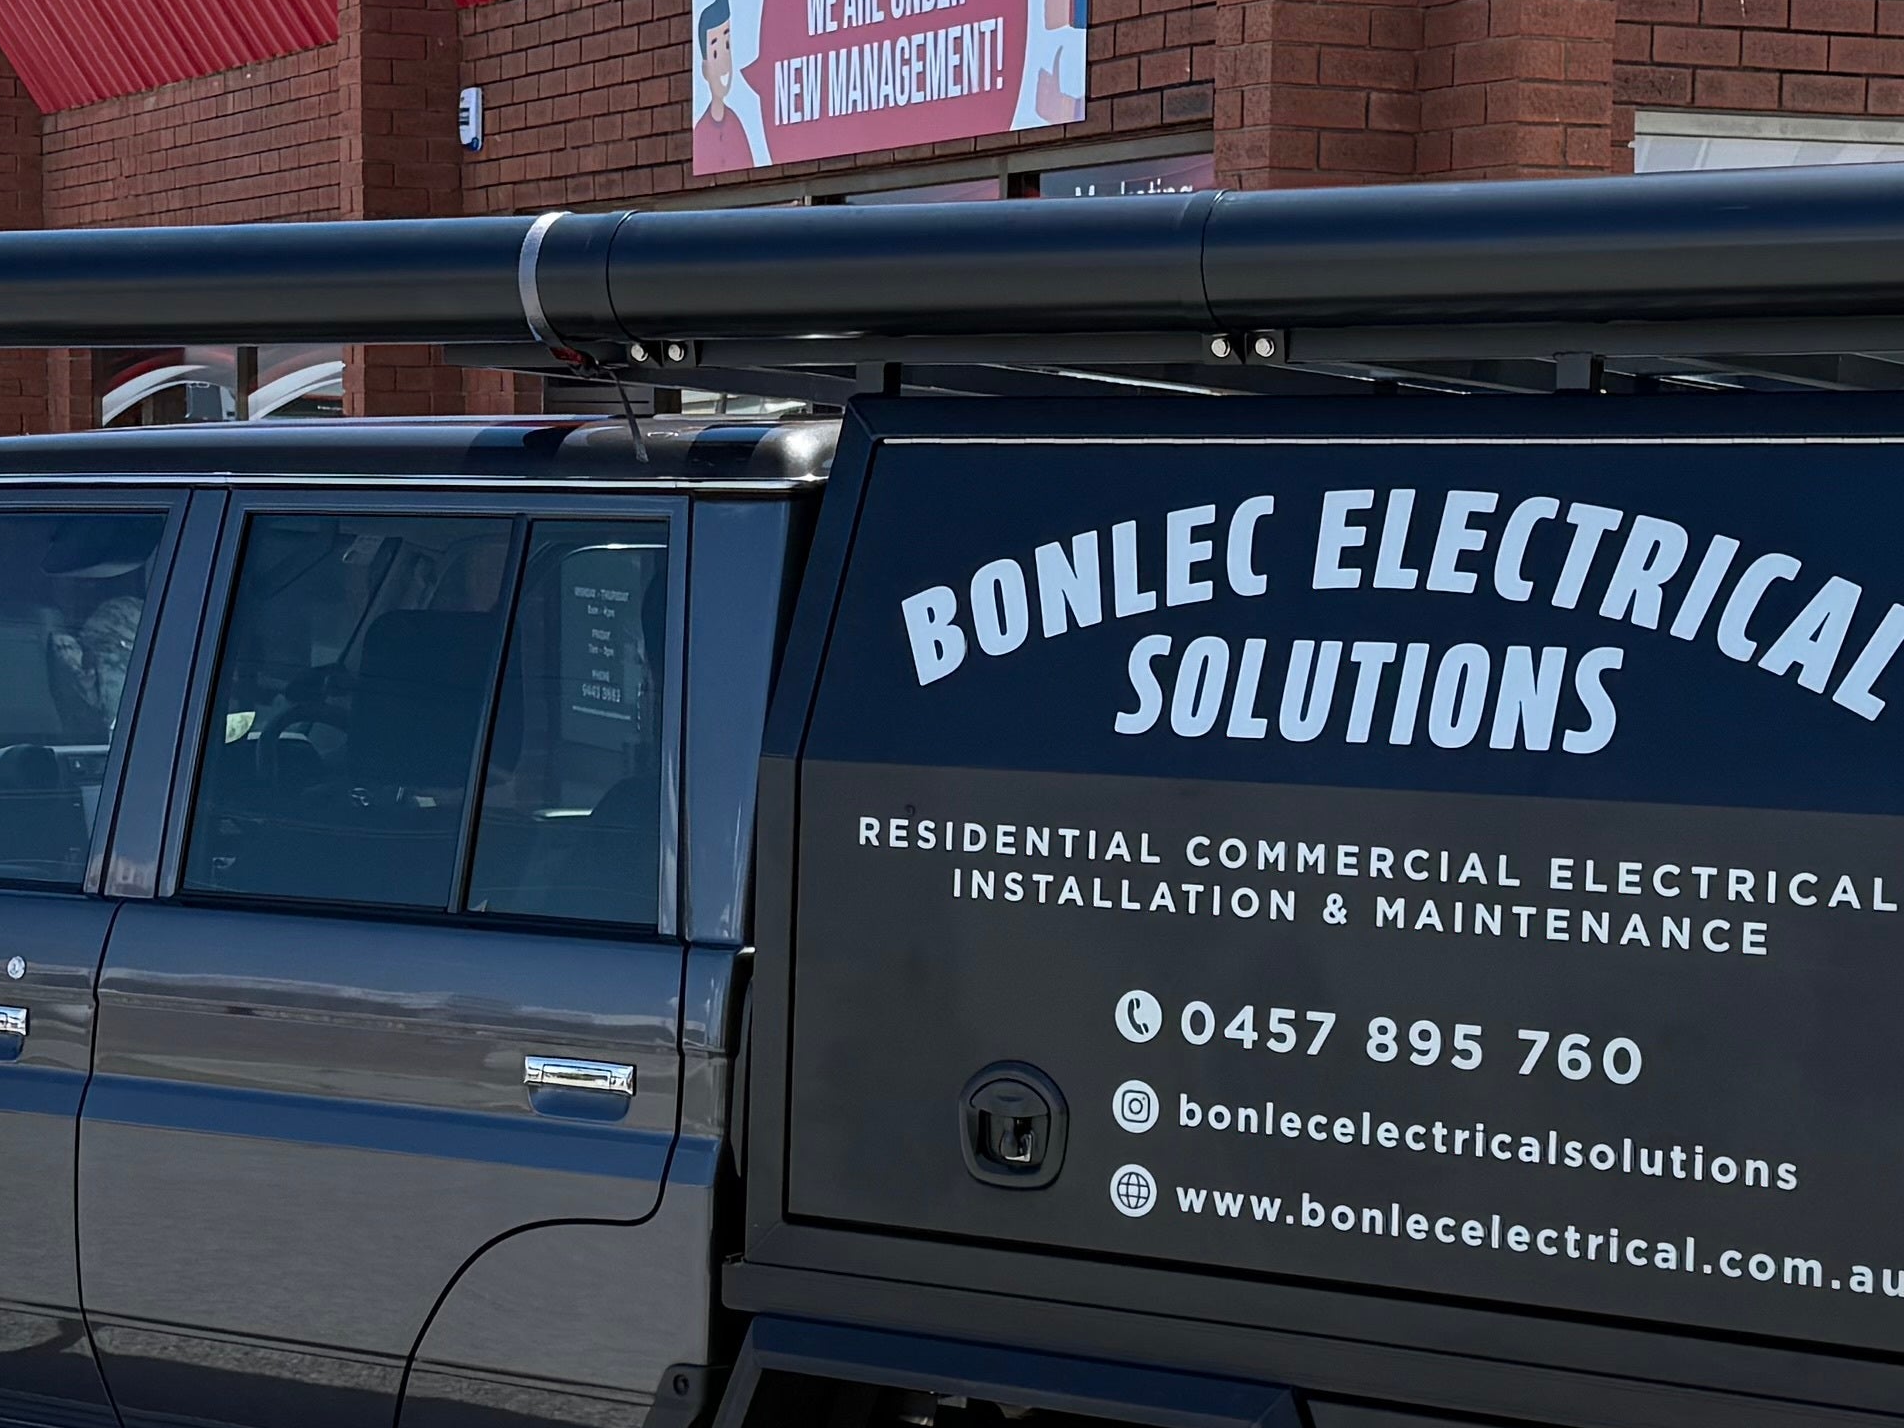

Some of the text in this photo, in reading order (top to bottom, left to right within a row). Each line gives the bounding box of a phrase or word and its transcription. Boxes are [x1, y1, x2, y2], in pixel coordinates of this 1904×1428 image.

[774, 18, 1004, 126] NEW MANAGEMENT!
[901, 495, 1274, 687] BONLEC
[1113, 633, 1624, 754] SOLUTIONS
[858, 816, 1898, 913] RESIDENTIAL COMMERCIAL ELECTRICAL
[952, 869, 1768, 956] INSTALLATION & MAINTENANCE
[1180, 1001, 1642, 1084] 0457 895 760
[1178, 1094, 1798, 1192] bonlecelectricalsolutions
